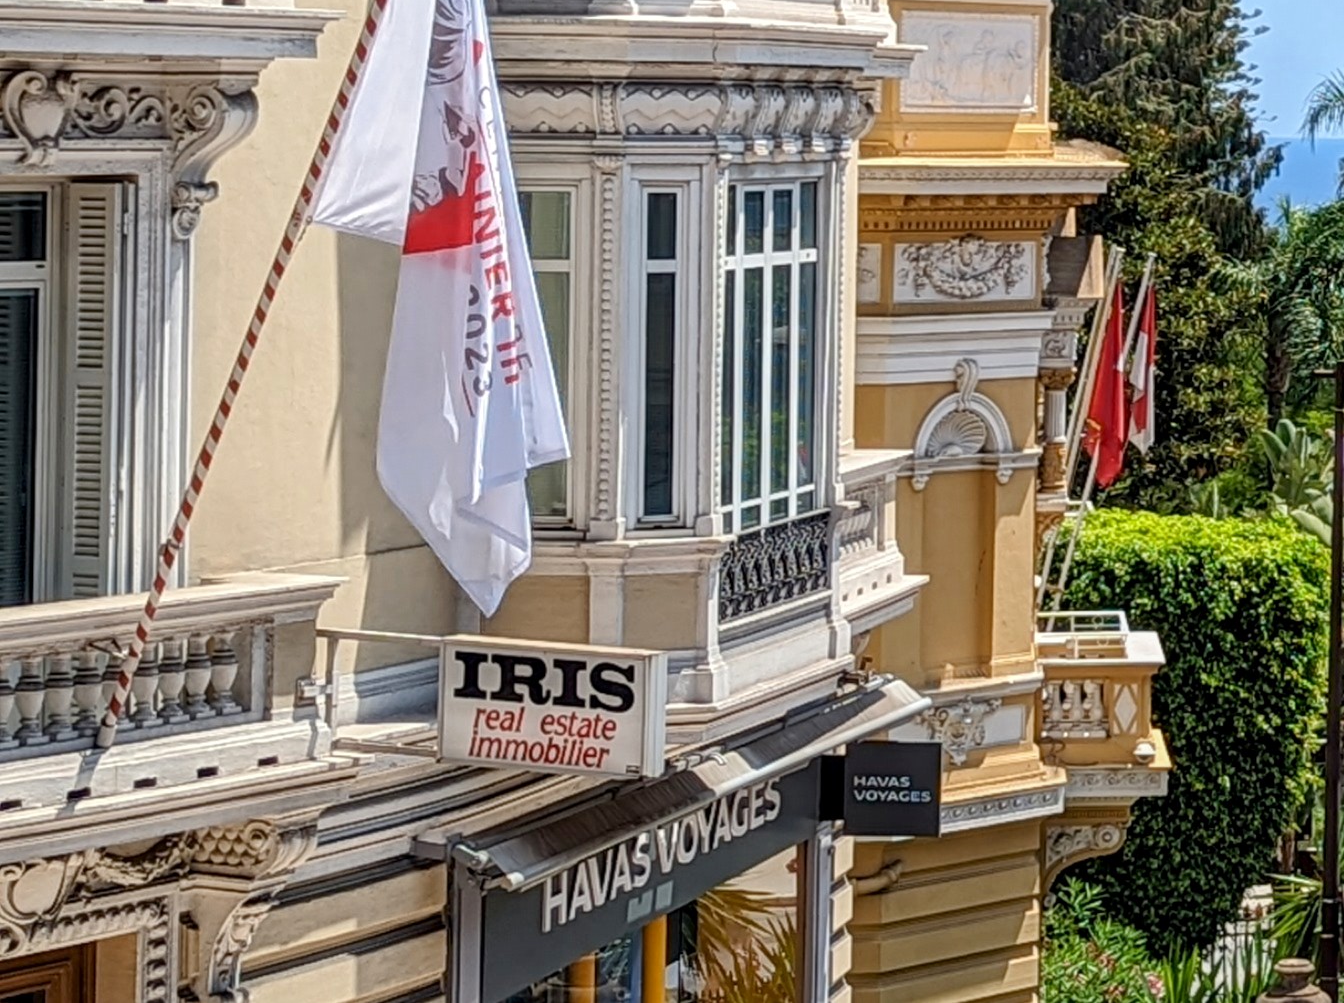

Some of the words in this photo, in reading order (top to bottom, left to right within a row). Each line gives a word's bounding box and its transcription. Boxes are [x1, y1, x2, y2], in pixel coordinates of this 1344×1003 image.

[453, 650, 635, 714] IRIS
[473, 706, 526, 733] real
[540, 711, 617, 741] estate
[468, 729, 610, 769] immobilier
[853, 776, 911, 788] HAVAS
[853, 789, 932, 803] VOYAGES
[541, 831, 651, 933] HAVAS
[656, 777, 782, 874] VOYAGES
